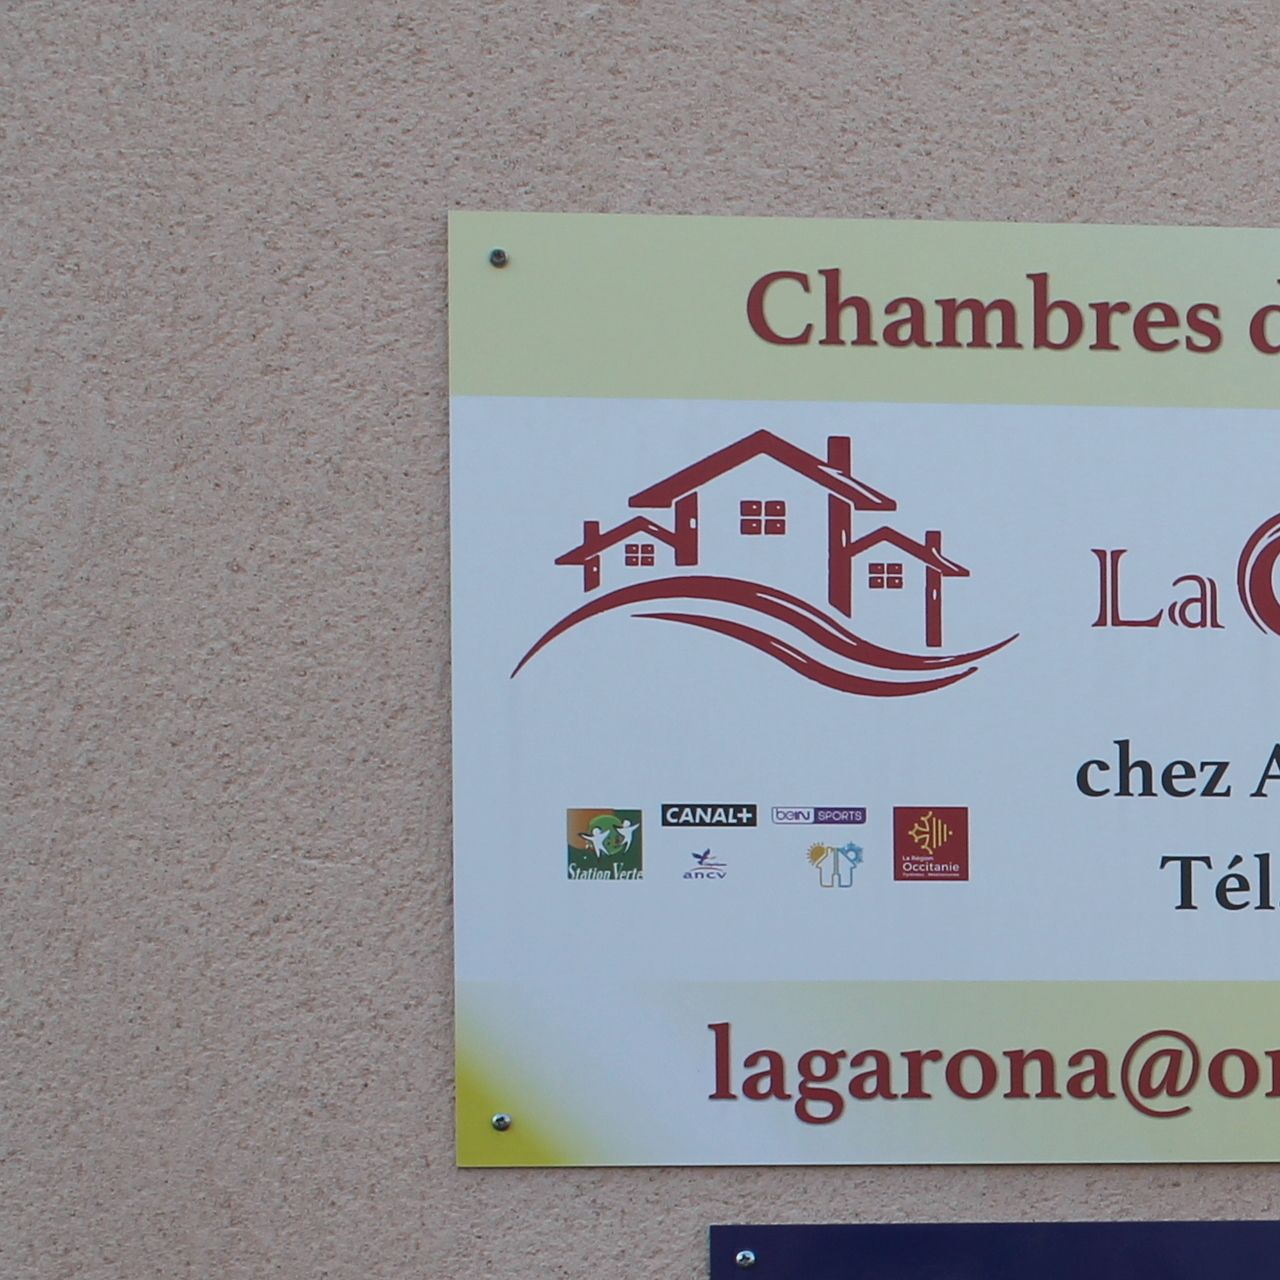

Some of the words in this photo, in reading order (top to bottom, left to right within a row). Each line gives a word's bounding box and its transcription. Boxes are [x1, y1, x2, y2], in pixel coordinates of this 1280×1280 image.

[745, 267, 1224, 355] Chambres
[1090, 549, 1225, 630] La
[1075, 739, 1232, 798] chez
[666, 807, 753, 824] CANAL+
[818, 810, 862, 821] SPORTS
[568, 862, 611, 880] Station
[613, 862, 644, 880] Verte
[902, 861, 960, 872] Occitanie
[682, 871, 728, 880] ancv
